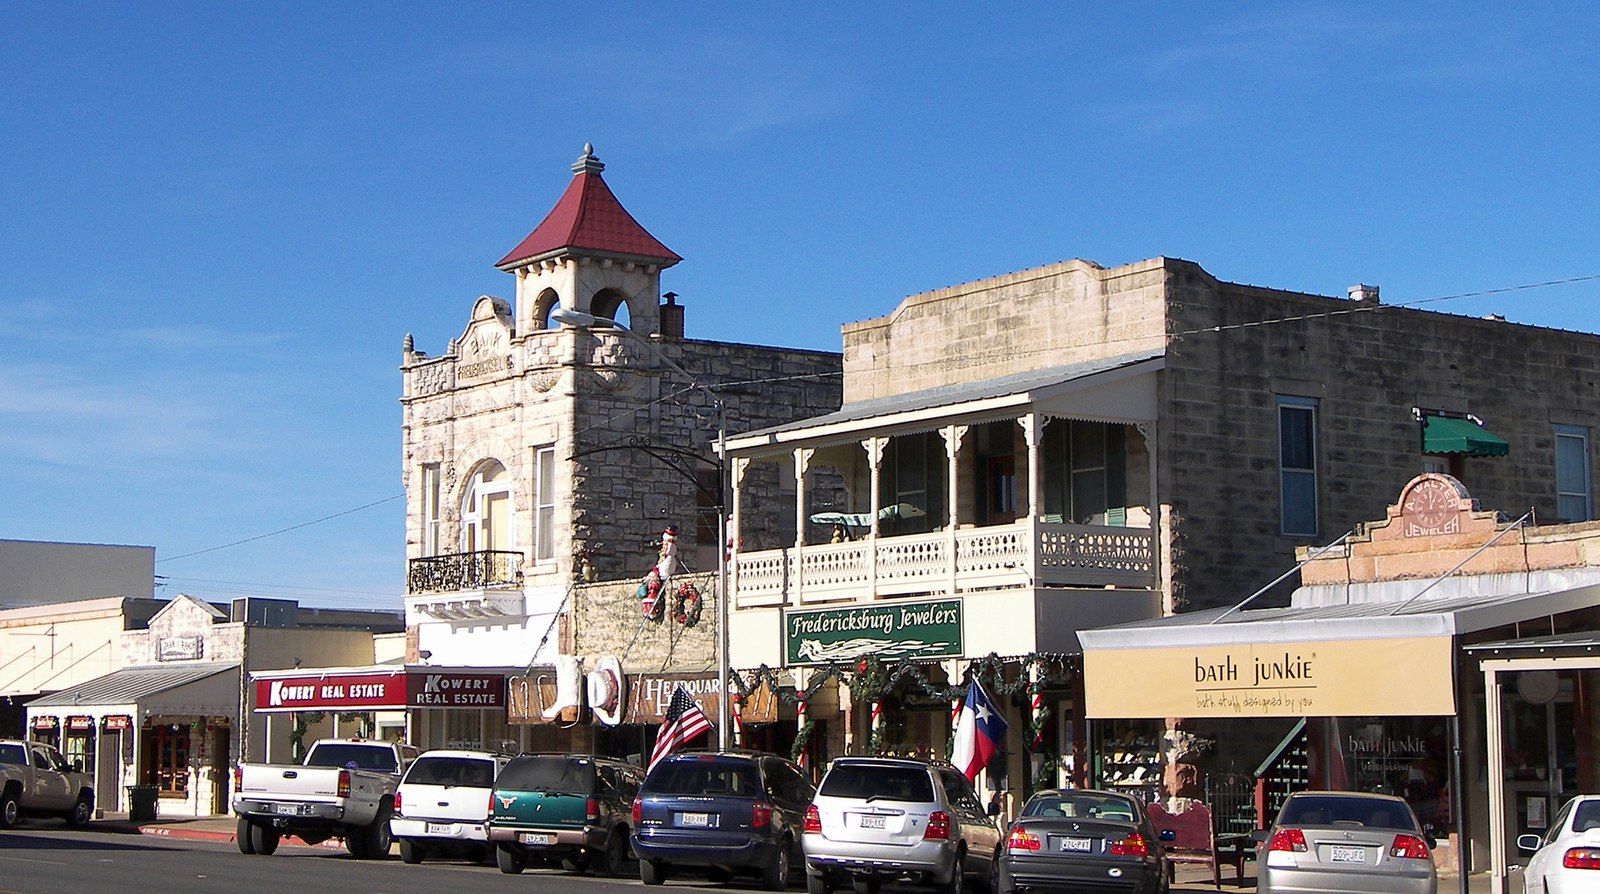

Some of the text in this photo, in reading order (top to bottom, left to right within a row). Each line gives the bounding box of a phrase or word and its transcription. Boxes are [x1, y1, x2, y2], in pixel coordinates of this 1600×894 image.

[470, 331, 502, 356] BANK
[1412, 480, 1458, 509] WALTER
[1405, 514, 1460, 537] JEWELER
[791, 603, 958, 638] Fredericksburg Jewelers
[269, 681, 385, 706] KOWERT REAL ESTATE
[424, 674, 489, 693] KOWERT
[416, 693, 496, 704] REAL ESTATE
[1196, 690, 1313, 713] bath stuff designed by you
